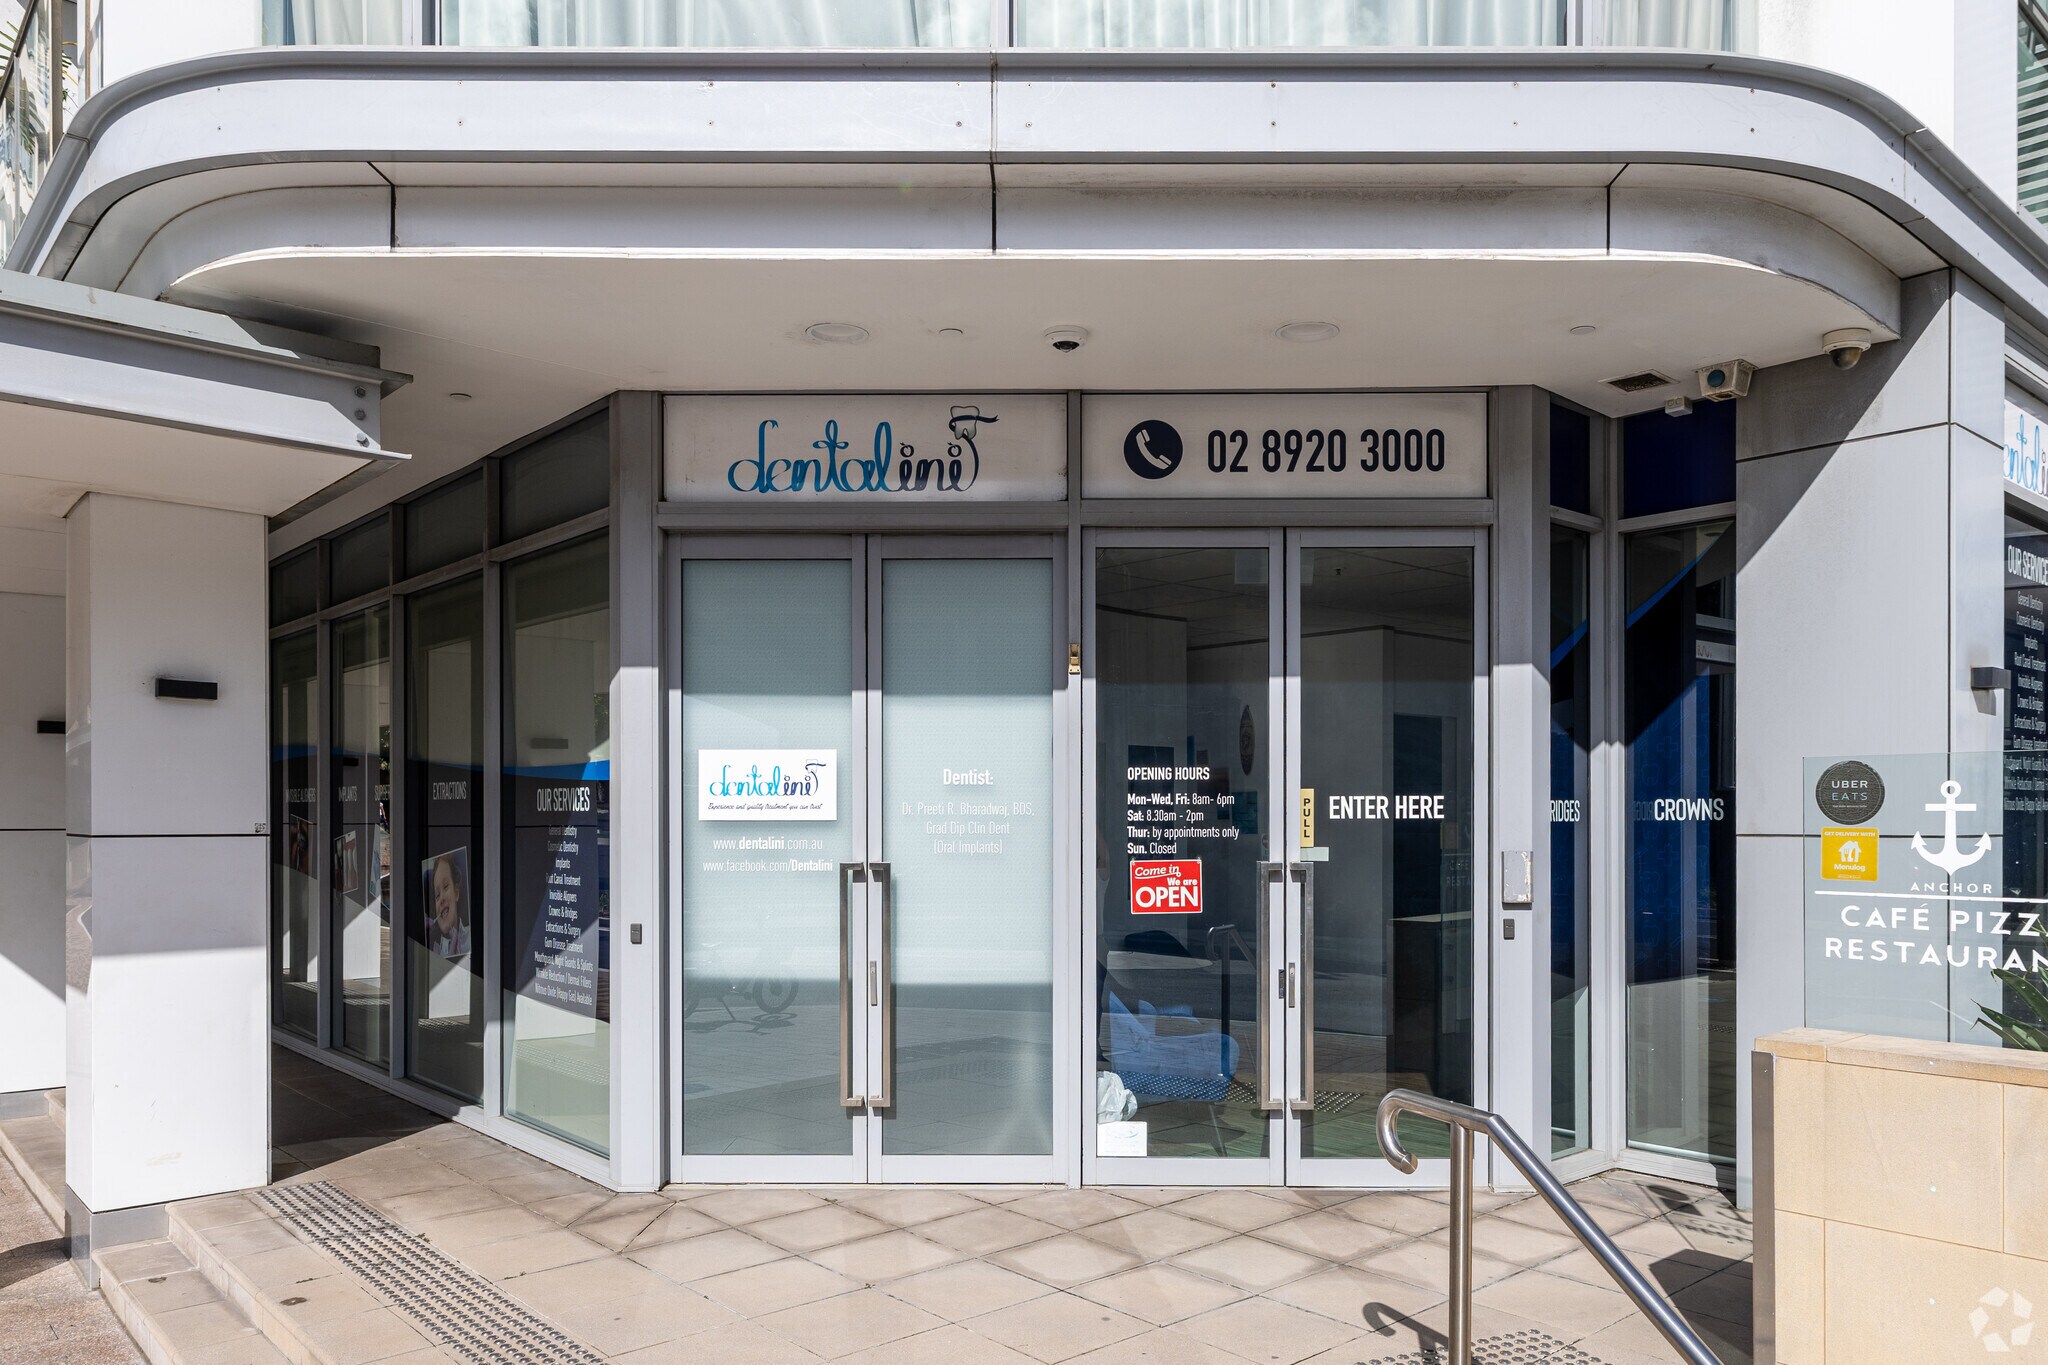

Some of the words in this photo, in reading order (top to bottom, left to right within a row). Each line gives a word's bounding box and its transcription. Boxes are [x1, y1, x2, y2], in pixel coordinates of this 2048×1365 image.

[728, 418, 979, 494] dentalini
[1207, 429, 1249, 473] 02
[1262, 429, 1347, 473] 8920
[1360, 428, 1446, 472] 3000
[2007, 544, 2022, 577] OUR
[709, 765, 819, 797] dentalini
[943, 768, 994, 787] Dentist:
[1127, 767, 1172, 781] OPENING
[1174, 767, 1210, 781] HOURS
[432, 781, 467, 800] EXTRACTIONS
[1831, 780, 1868, 789] UBER
[536, 788, 552, 812] OUR
[553, 787, 591, 812] SERVICES
[1127, 793, 1174, 807] Mon-Wed,
[1175, 793, 1191, 806] Fri:
[1192, 793, 1214, 806] 8am-
[1216, 793, 1235, 808] 6pm
[1832, 792, 1868, 801] EATS
[901, 802, 914, 816] Dr.
[917, 802, 944, 816] Preeti
[1328, 796, 1389, 820] ENTER
[1394, 796, 1445, 820] HERE
[1653, 798, 1725, 822] CROWNS
[1127, 809, 1145, 822] Sat:
[1146, 810, 1177, 822] 8.30am
[1185, 810, 1205, 824] 2pm
[1303, 798, 1311, 838] PULL
[926, 821, 948, 835] Grad
[949, 821, 966, 838] Dip
[968, 821, 986, 835] Clin
[988, 821, 1011, 835] Dent
[1127, 826, 1151, 839] Thur:
[1152, 826, 1163, 841] by
[1163, 826, 1221, 841] appointments
[1222, 826, 1240, 841] only
[713, 836, 823, 851] www.dentalini.com.au
[958, 839, 1003, 856] Implants)
[1127, 842, 1148, 855] Sun.
[1149, 842, 1177, 855] Closed
[703, 858, 833, 873] www.facebook.com/Dentalini
[1134, 865, 1166, 878] Come
[1167, 863, 1181, 878] in
[1833, 863, 1866, 873] Menulog
[1167, 877, 1181, 886] We
[1182, 878, 1198, 886] are
[1910, 881, 1993, 894] ANCHOR
[1134, 886, 1199, 908] OPEN
[1840, 903, 1930, 931] CAFÉ
[1951, 910, 2048, 937] PIZZ
